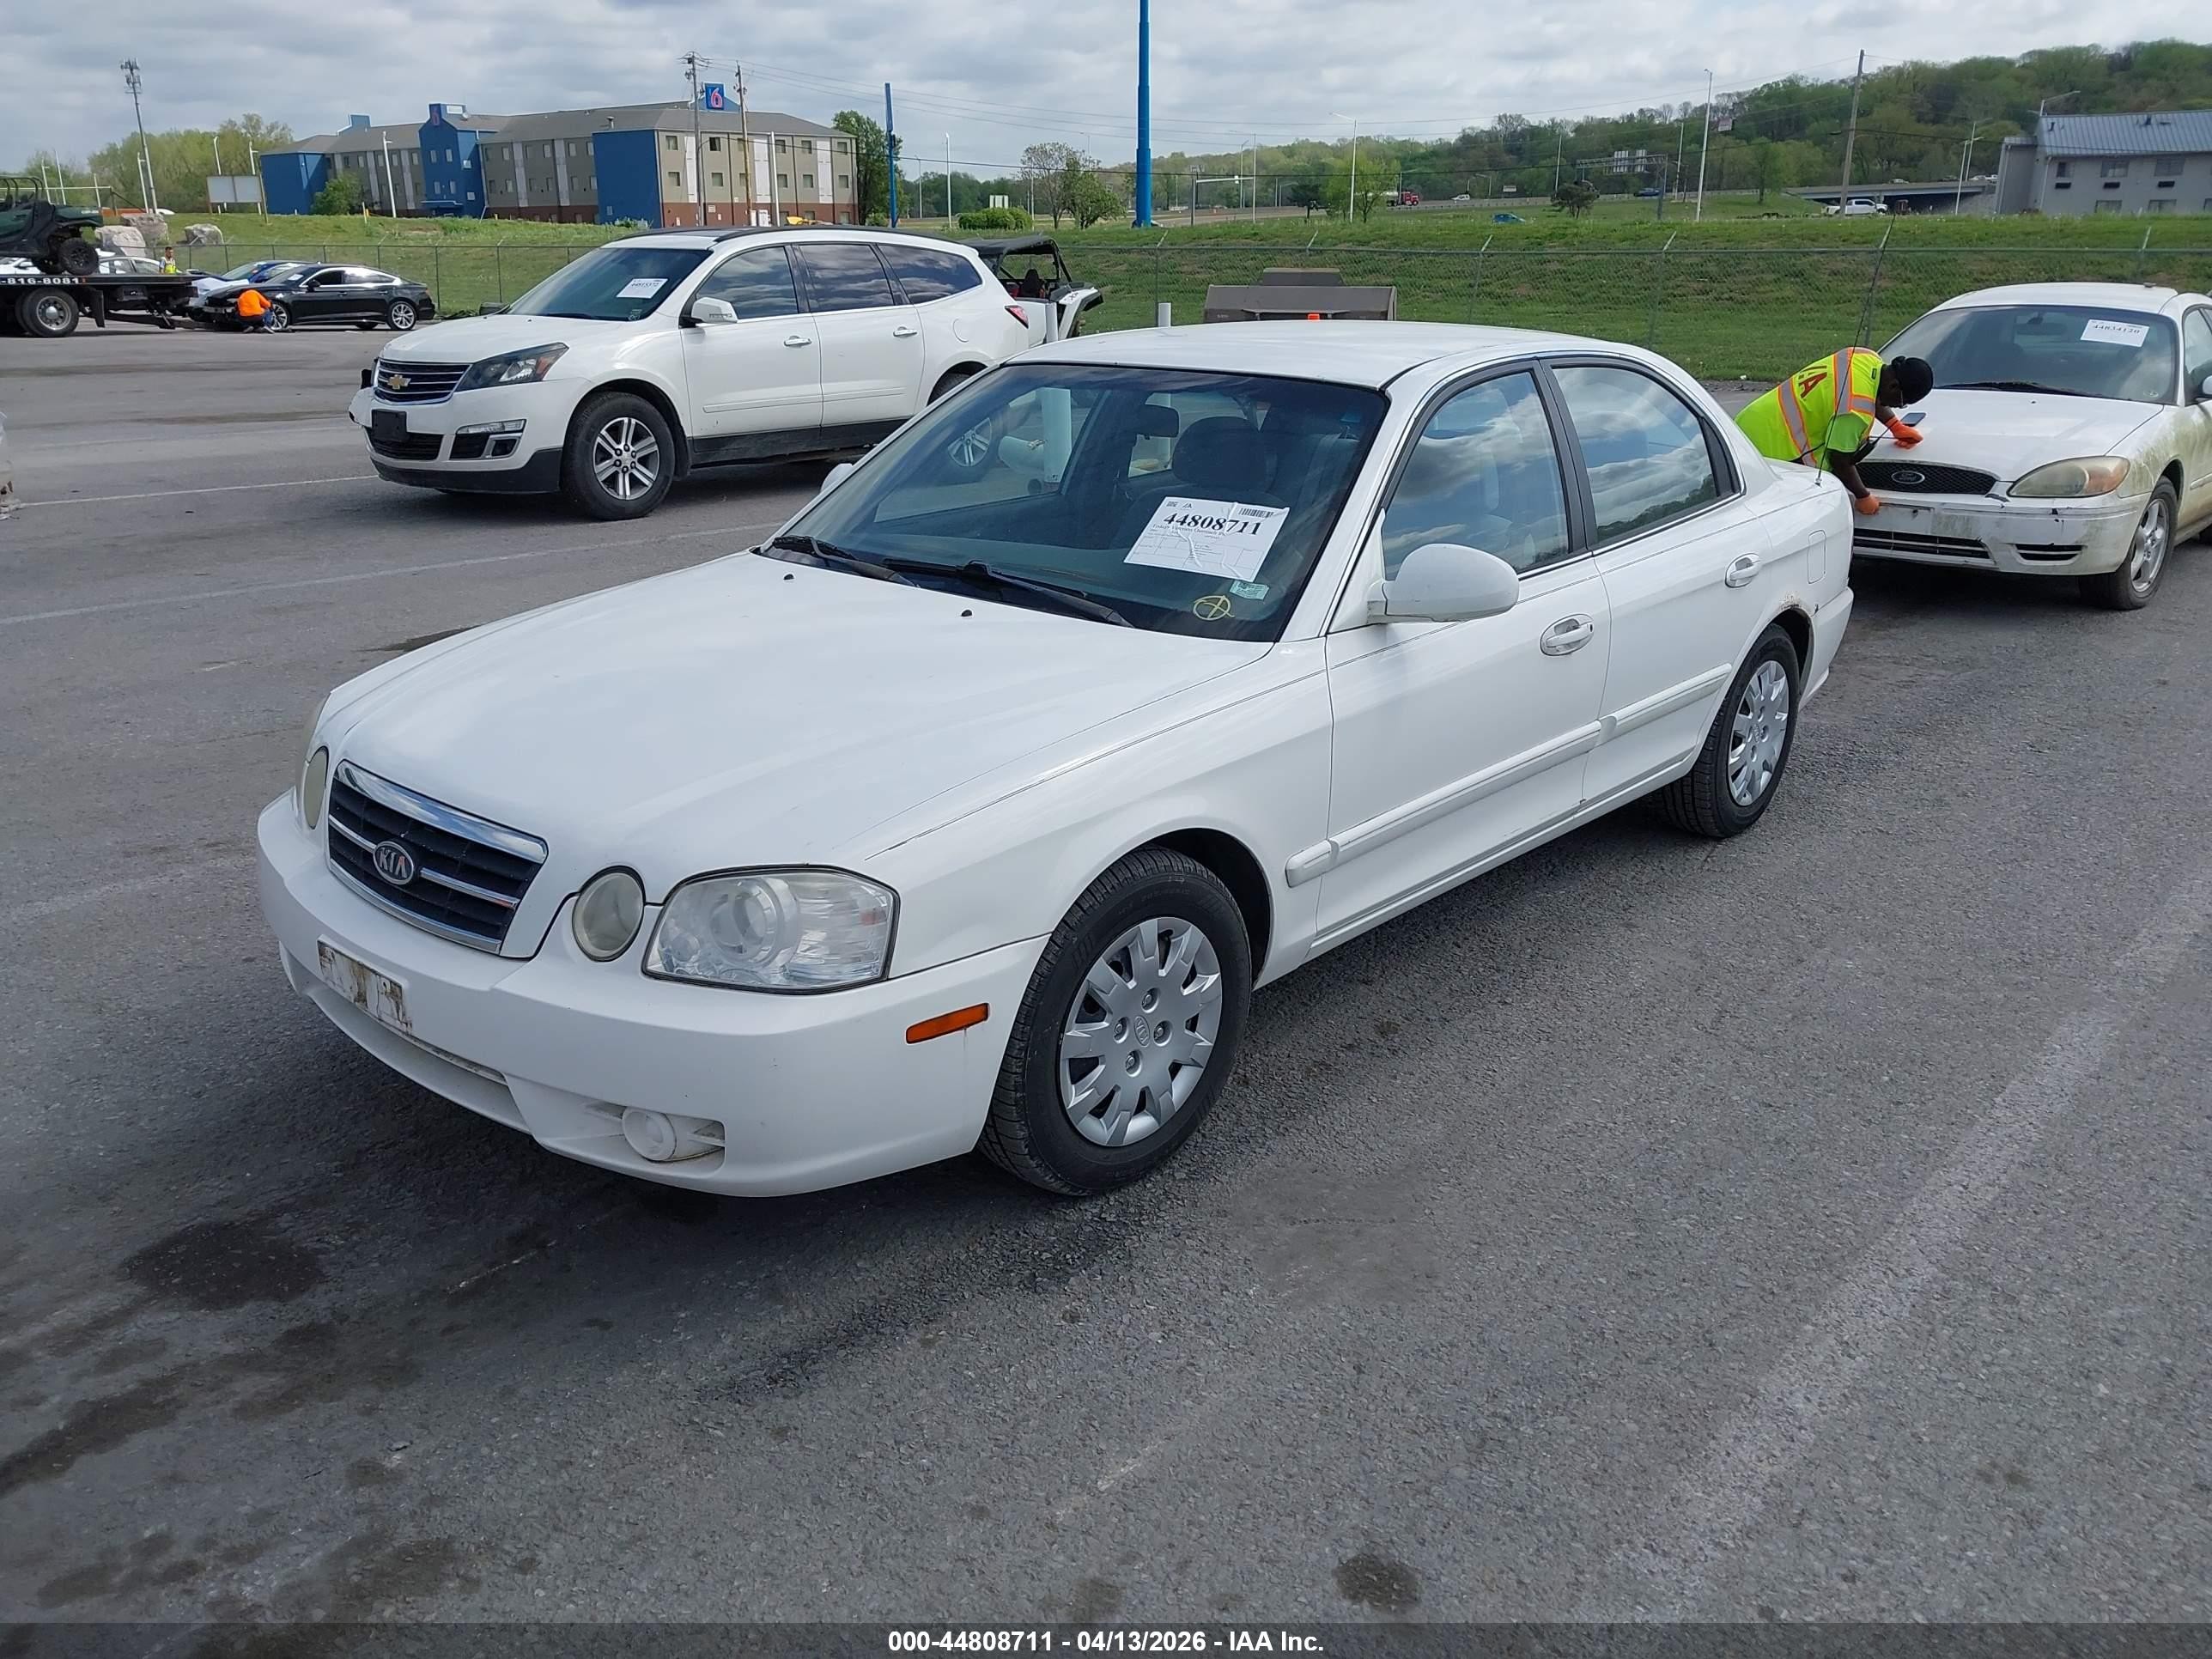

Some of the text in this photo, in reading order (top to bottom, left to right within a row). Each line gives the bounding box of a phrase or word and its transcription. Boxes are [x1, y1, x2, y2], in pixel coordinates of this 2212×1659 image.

[711, 88, 723, 108] 6
[1164, 512, 1261, 536] 44808711
[379, 847, 408, 878] KIA
